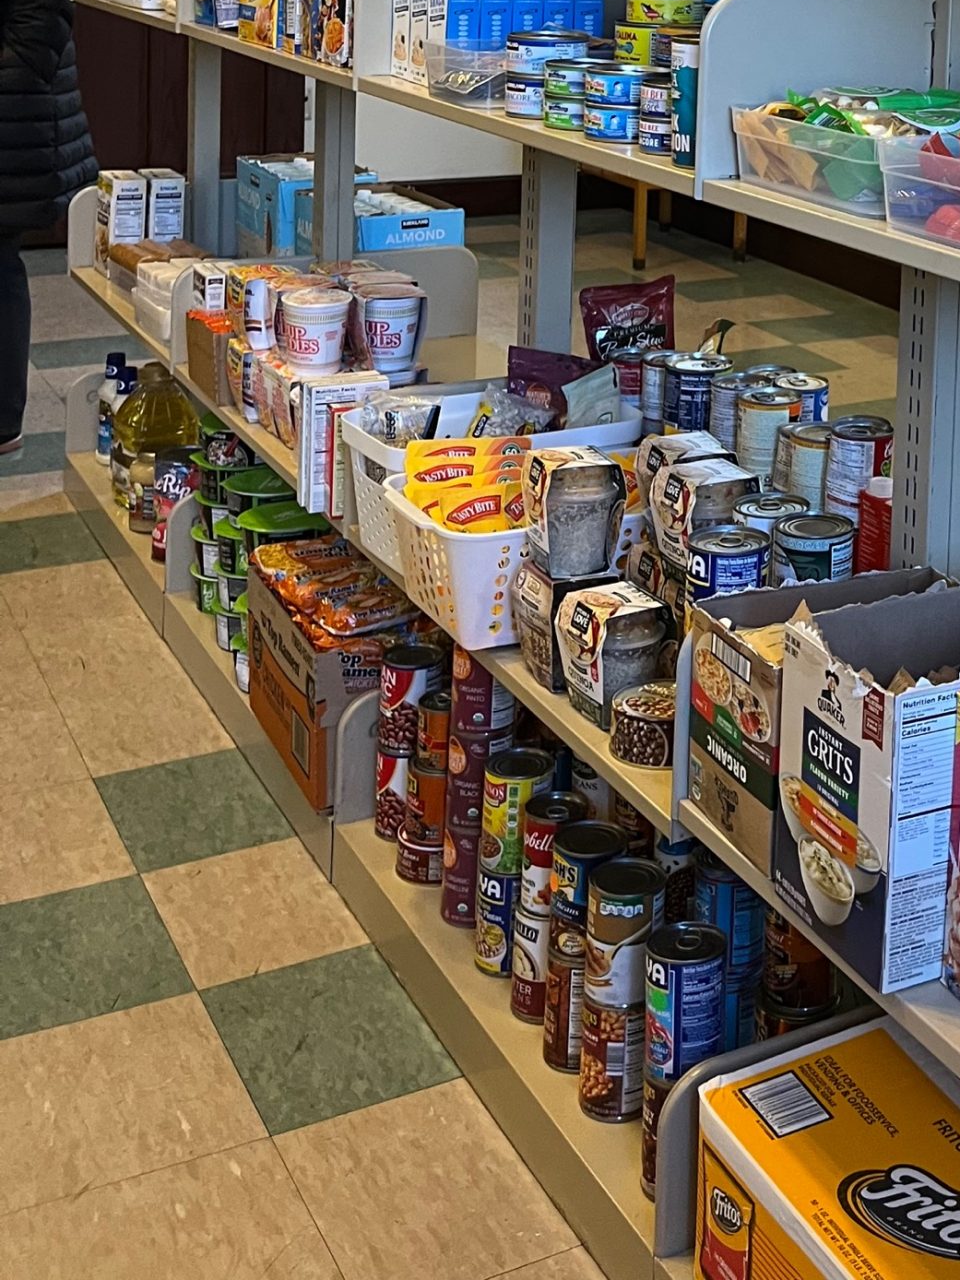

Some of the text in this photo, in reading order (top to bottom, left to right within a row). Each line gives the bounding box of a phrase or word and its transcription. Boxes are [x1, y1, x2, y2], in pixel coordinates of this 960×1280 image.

[385, 227, 446, 245] ALMOND
[613, 324, 651, 338] PREMIUM
[635, 331, 665, 348] Stew
[421, 467, 469, 483] TASTY BITE
[452, 499, 496, 522] TASTY BITE
[460, 684, 486, 694] ORGANIC
[466, 695, 486, 703] PINTO
[817, 696, 847, 726] QUAKER
[902, 697, 936, 711] Nutrition
[818, 726, 843, 752] INSTANT
[901, 725, 932, 738] Calories
[706, 735, 748, 784] ORGANIC
[807, 728, 854, 785] GRITS
[809, 763, 849, 800] FLAVOR VARIETY
[459, 790, 479, 798] BLACK
[814, 1057, 877, 1126] VENDING & OFFICES
[823, 1054, 900, 1139] IDEAL FOR FOODSERVICE,
[711, 1185, 743, 1226] Fritos
[887, 1216, 925, 1240] BRAND
